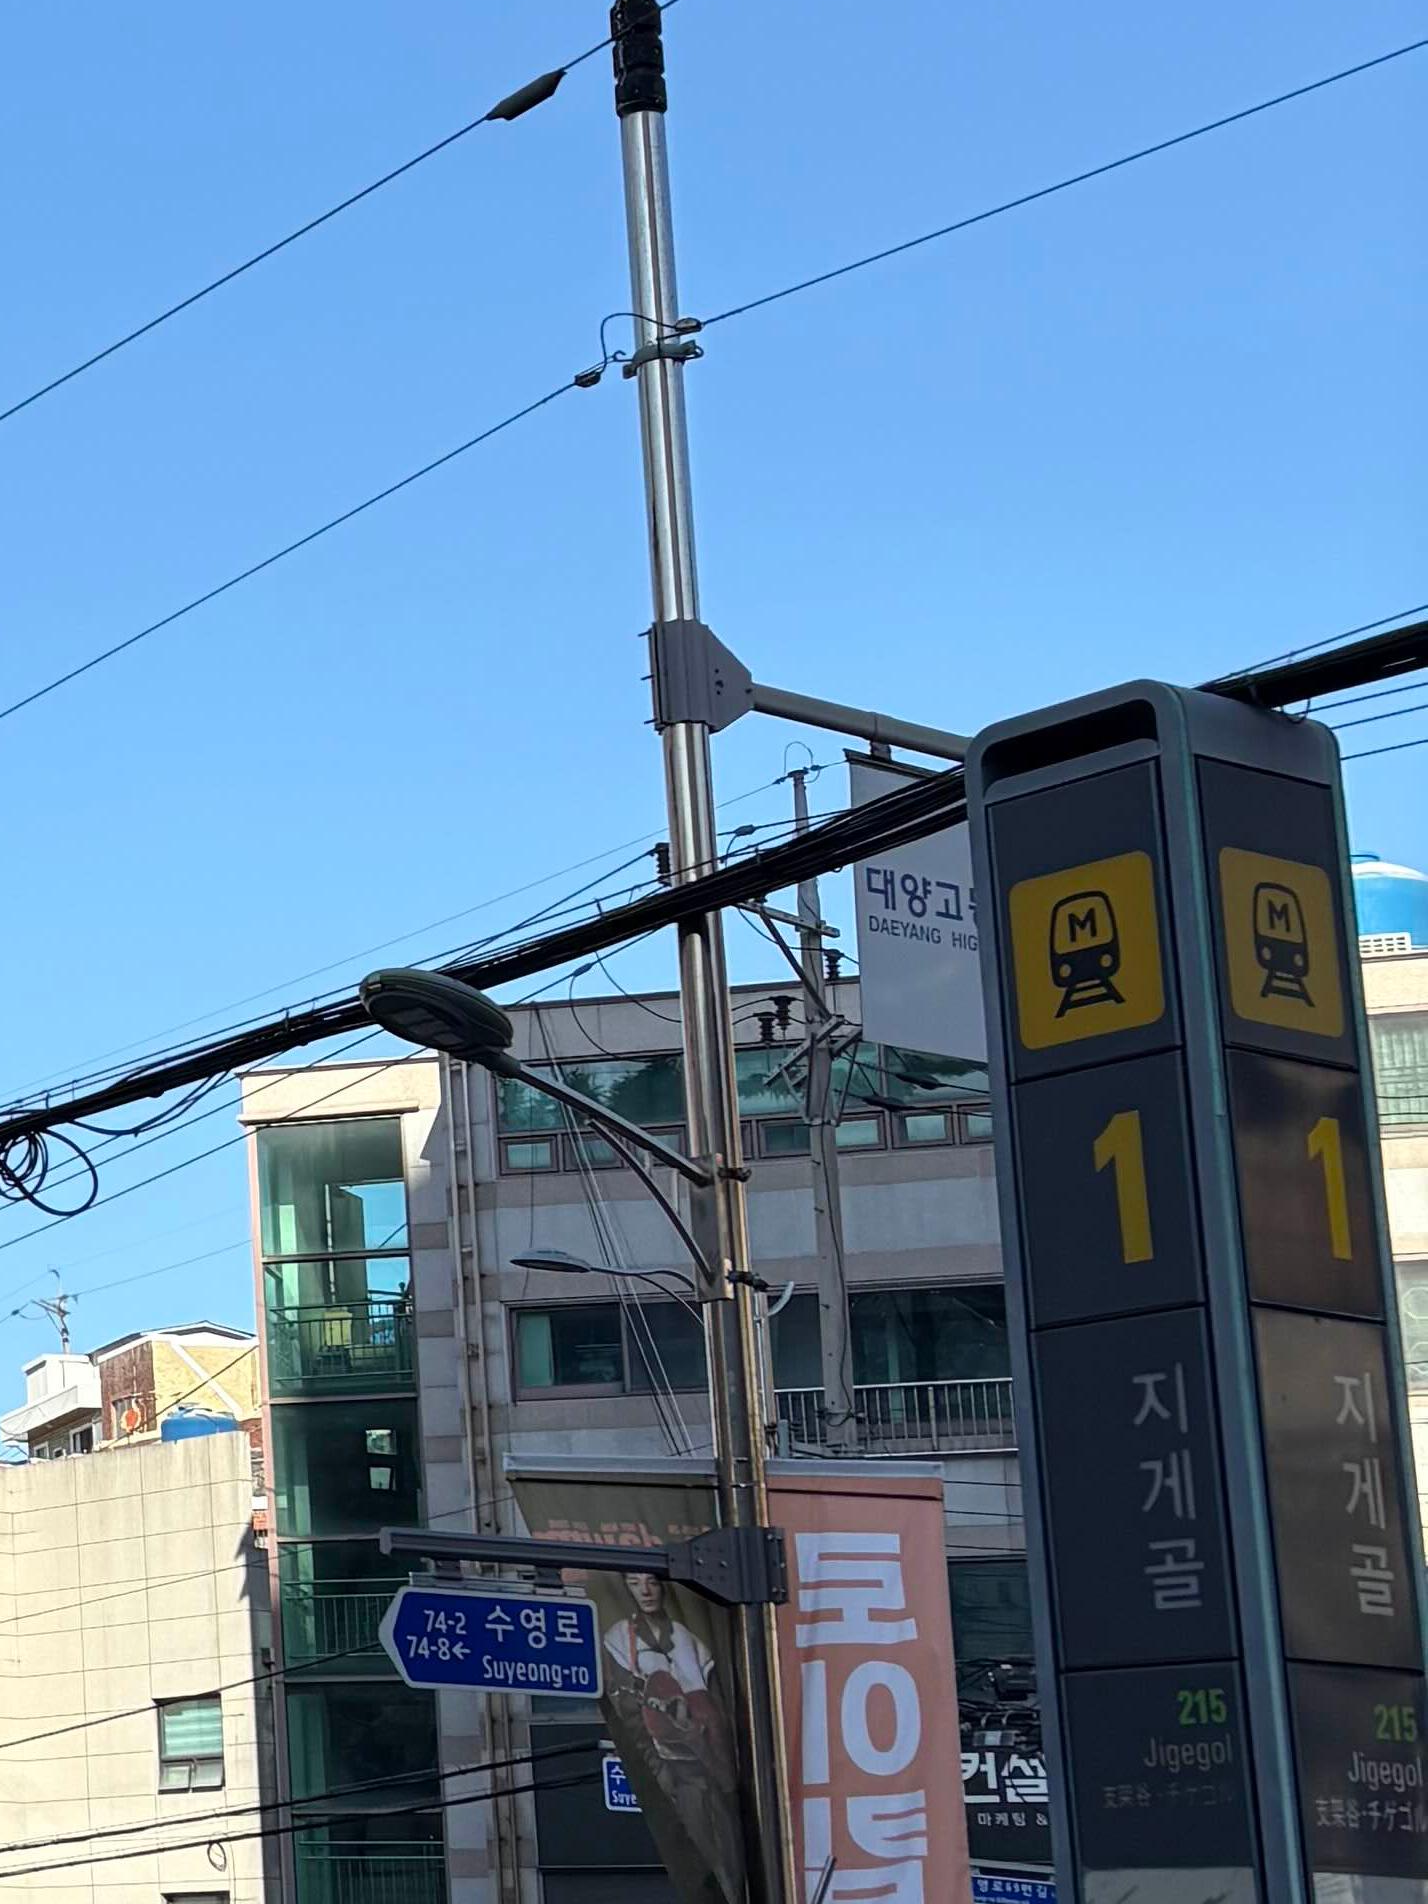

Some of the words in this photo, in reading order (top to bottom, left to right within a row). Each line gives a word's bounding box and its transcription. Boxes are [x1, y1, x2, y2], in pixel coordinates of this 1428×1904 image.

[869, 915, 941, 945] DAEYANG
[1093, 1110, 1154, 1264] 1
[1307, 1117, 1352, 1260] 1
[1132, 1361, 1205, 1610] 지게골
[1333, 1372, 1395, 1617] 지게골
[423, 1609, 468, 1636] 74-2
[484, 1605, 584, 1649] 수영로
[406, 1635, 452, 1661] 74-8
[482, 1654, 590, 1688] Suyeong-ro
[1176, 1689, 1227, 1726] 215
[1373, 1703, 1419, 1742] 215
[1143, 1733, 1233, 1773] Jigegol
[1348, 1751, 1425, 1793] Jigegol
